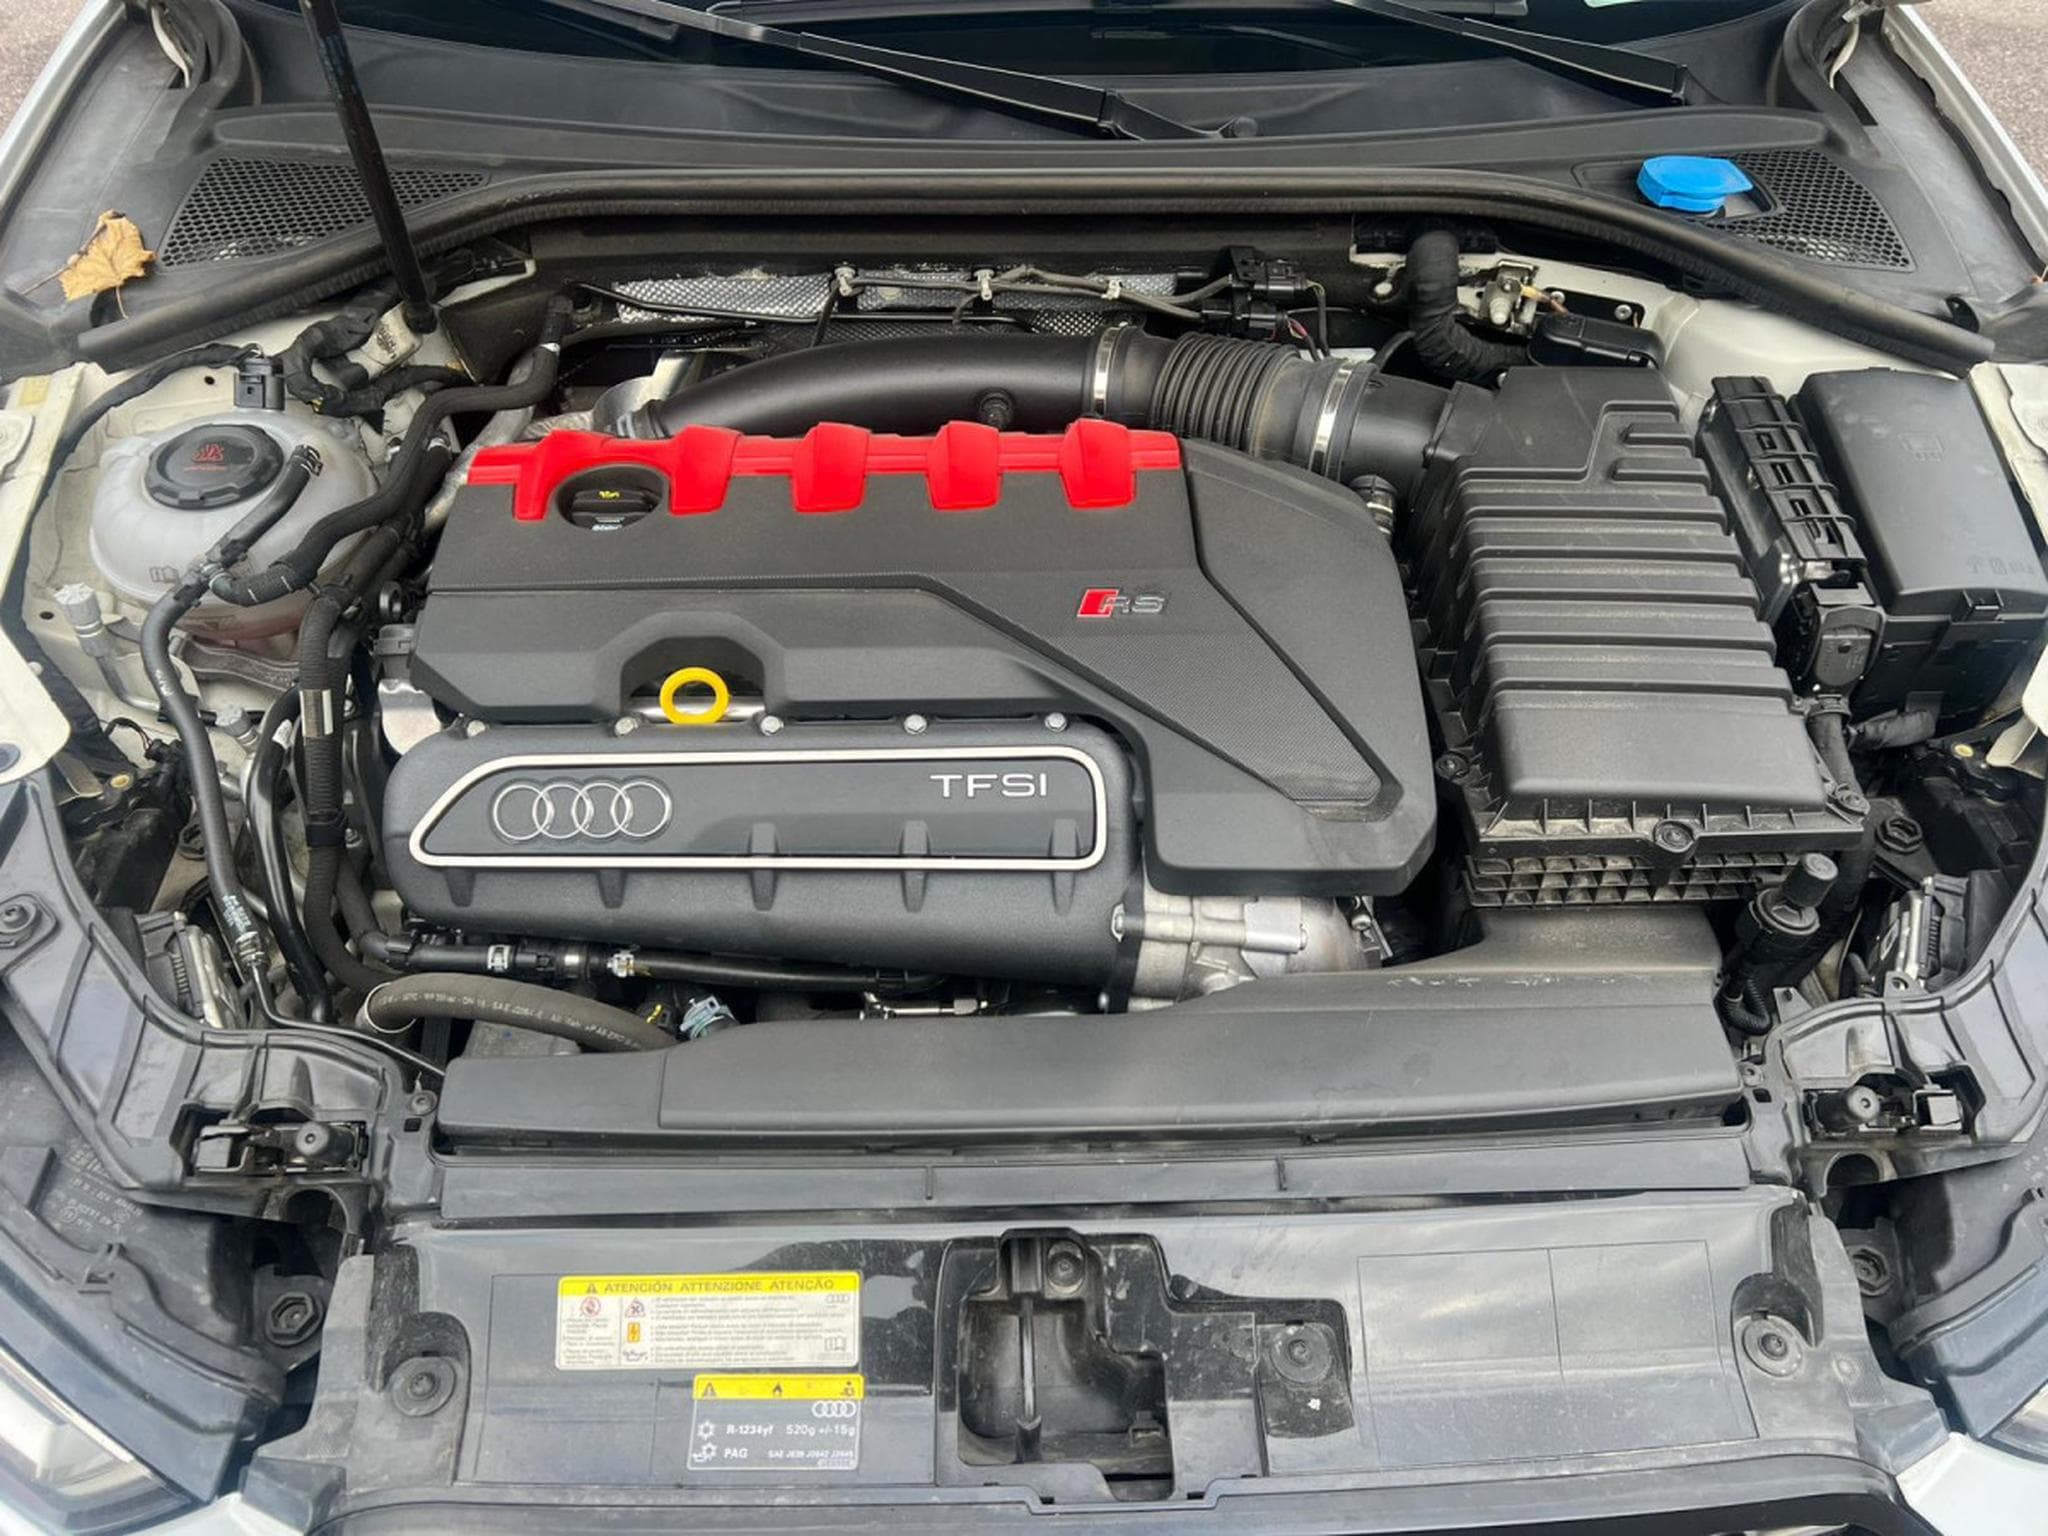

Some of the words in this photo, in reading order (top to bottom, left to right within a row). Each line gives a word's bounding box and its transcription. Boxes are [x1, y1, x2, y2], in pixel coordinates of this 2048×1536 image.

[1086, 592, 1165, 615] RS
[929, 773, 1046, 798] TFSI
[604, 1280, 673, 1294] ATENCIÓN
[680, 1280, 763, 1293] ATTENZIONE
[786, 1424, 816, 1437] 520g
[724, 1447, 749, 1459] PAG
